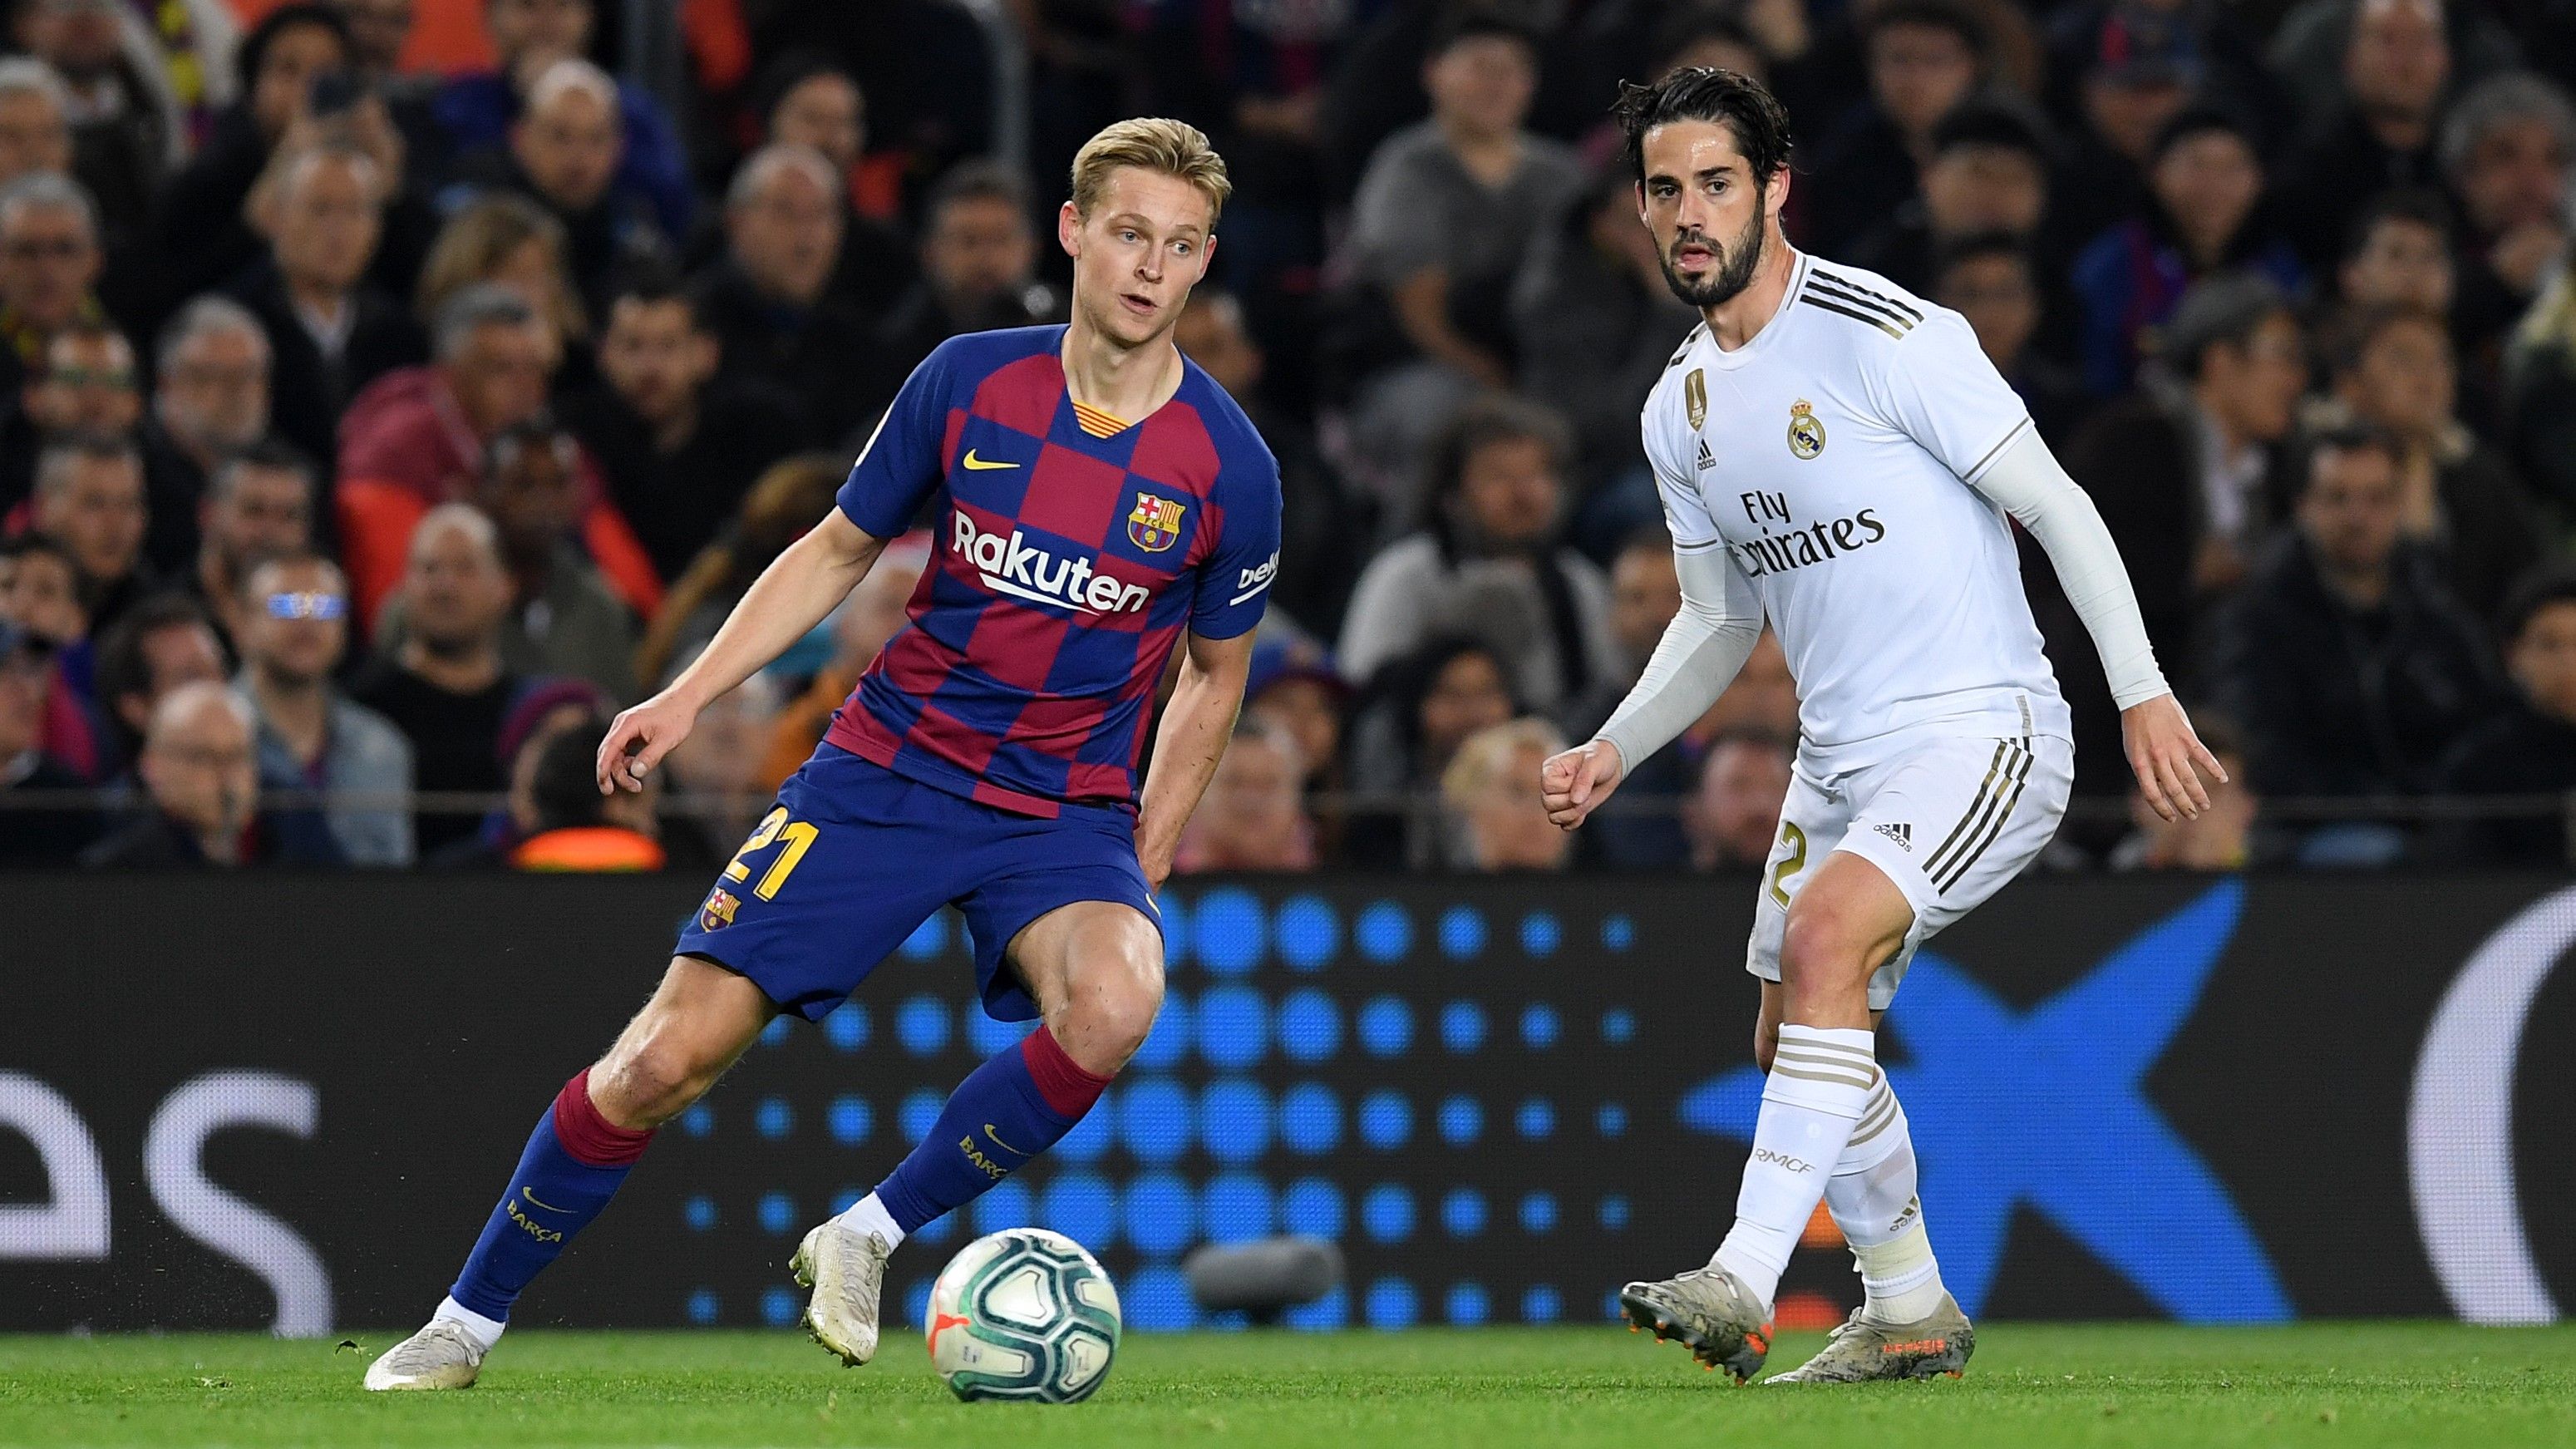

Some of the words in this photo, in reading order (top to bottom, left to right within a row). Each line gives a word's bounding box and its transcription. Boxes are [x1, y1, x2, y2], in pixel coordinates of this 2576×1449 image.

[1144, 517, 1165, 529] FCB
[1740, 490, 1791, 525] Fly
[953, 510, 1150, 613] Rakuten
[1237, 547, 1281, 589] bek
[722, 806, 820, 903] 21
[1873, 824, 1913, 853] adidas
[959, 1134, 1008, 1180] BARÇ
[1756, 1148, 1816, 1174] RMCF
[507, 1199, 562, 1243] BARÇA
